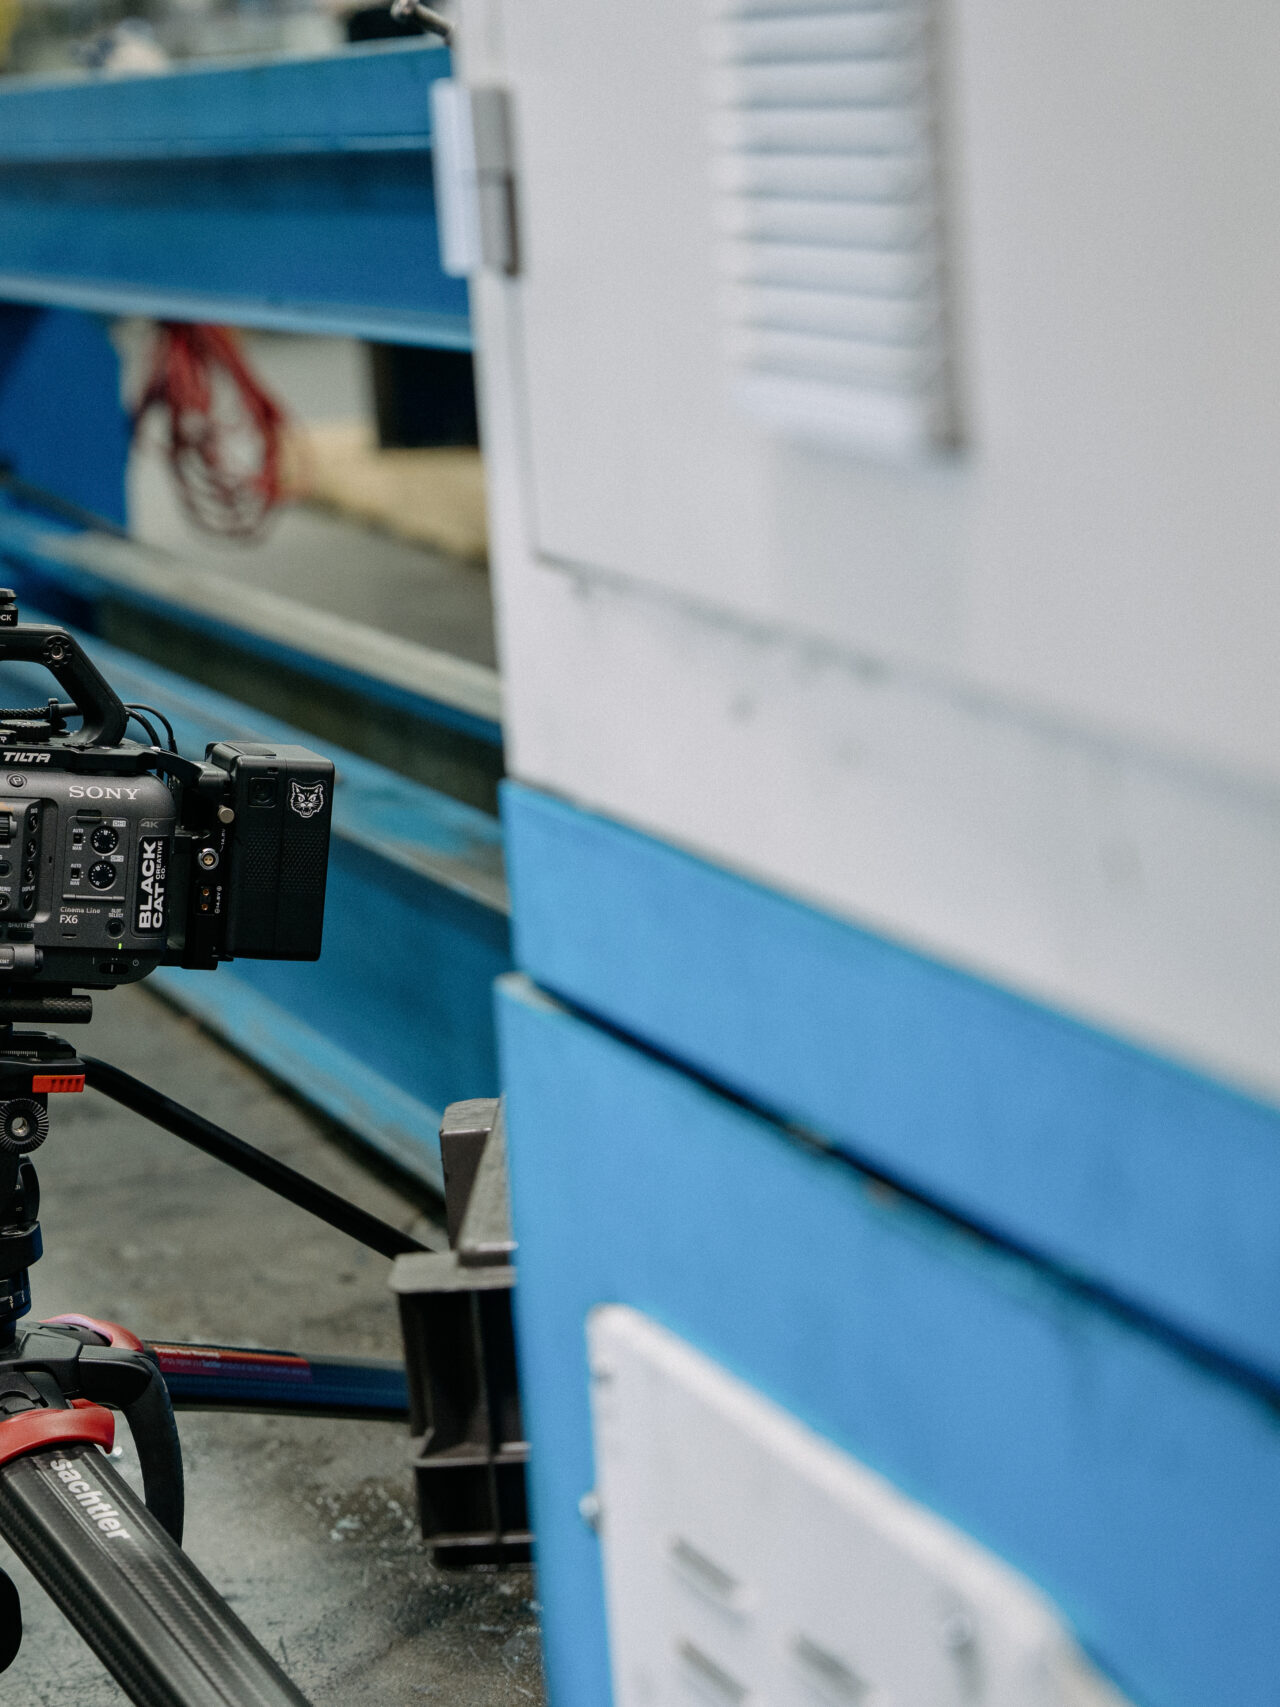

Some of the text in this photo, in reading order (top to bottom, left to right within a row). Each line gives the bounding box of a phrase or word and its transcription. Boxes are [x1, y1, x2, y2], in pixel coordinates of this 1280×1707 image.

[3, 751, 51, 763] TILTA
[68, 785, 141, 800] SONY
[141, 821, 159, 829] 4K
[155, 840, 163, 879] CREATIVE
[138, 841, 157, 928] BLACK
[60, 906, 85, 914] Cinema
[152, 882, 165, 928] CAT
[59, 915, 78, 924] FX6
[50, 1459, 132, 1539] sachtler
